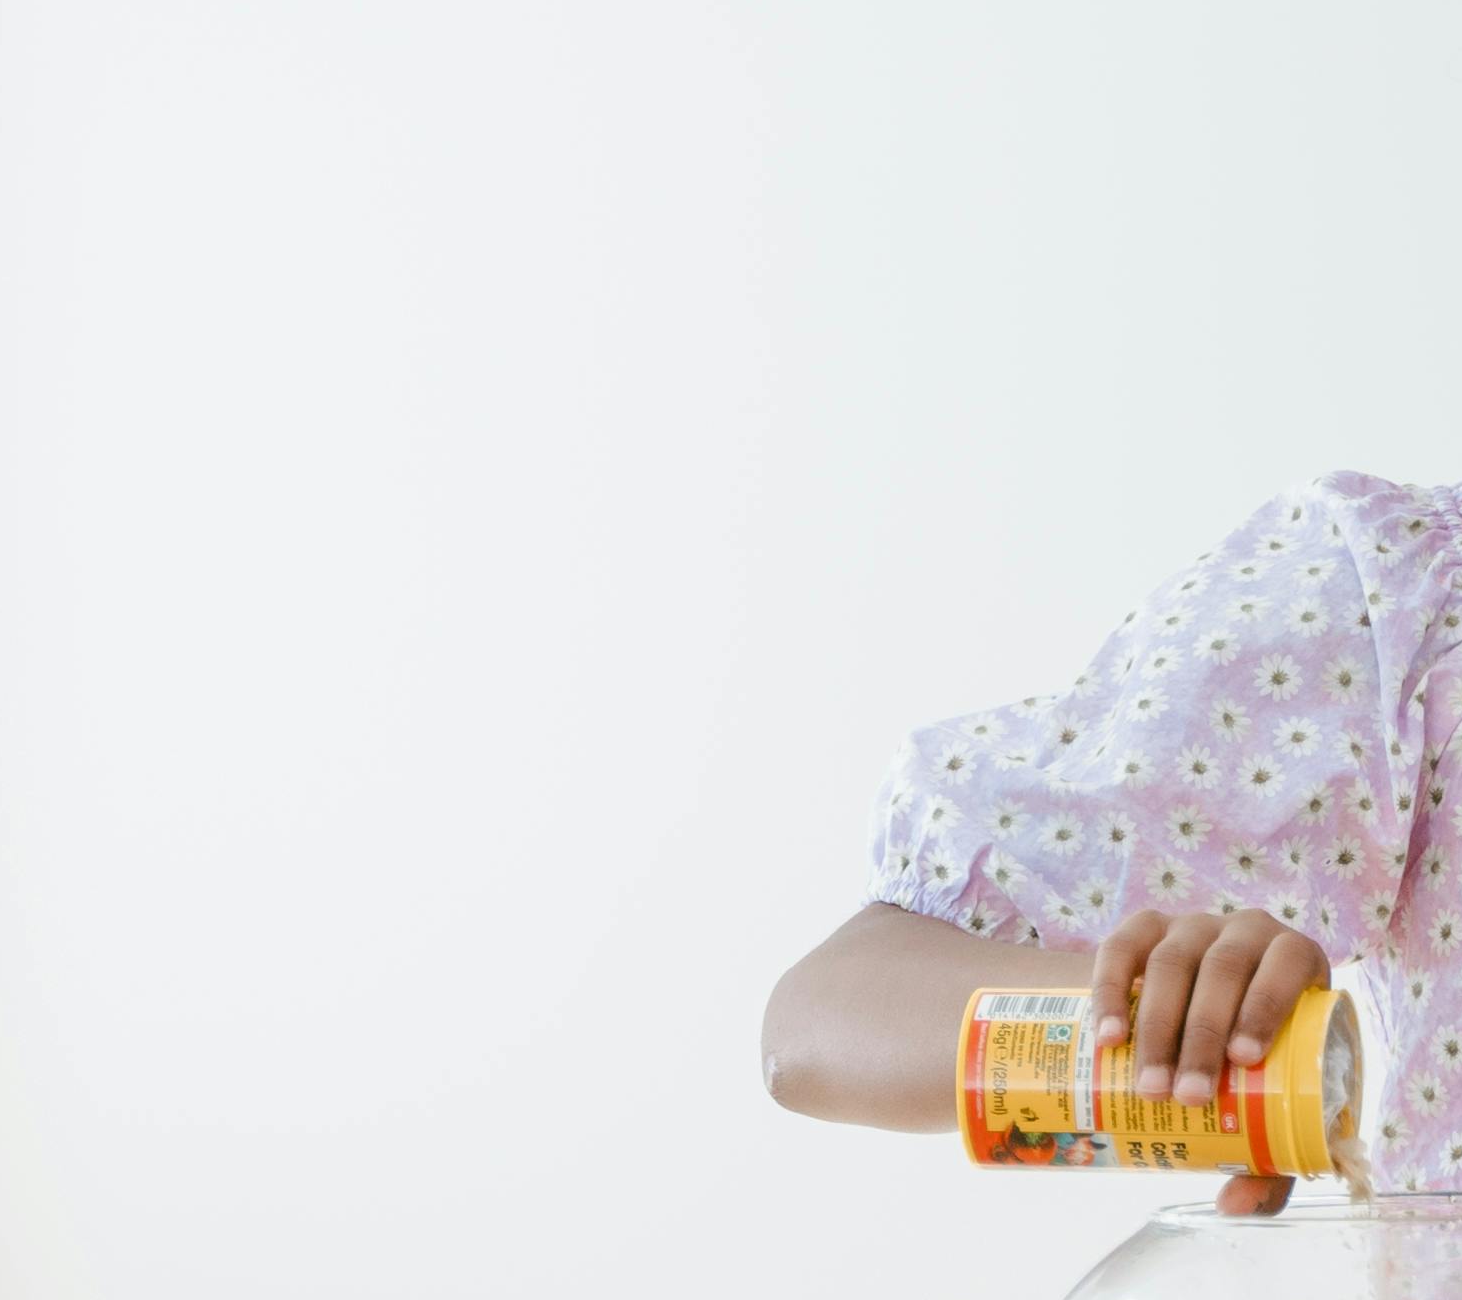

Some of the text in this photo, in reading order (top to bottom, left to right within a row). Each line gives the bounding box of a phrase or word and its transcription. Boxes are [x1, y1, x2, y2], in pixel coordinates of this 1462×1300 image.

[1225, 1116, 1234, 1129] UK
[1126, 1141, 1145, 1161] For
[1150, 1142, 1176, 1170] Goldf
[1170, 1142, 1190, 1161] Für
